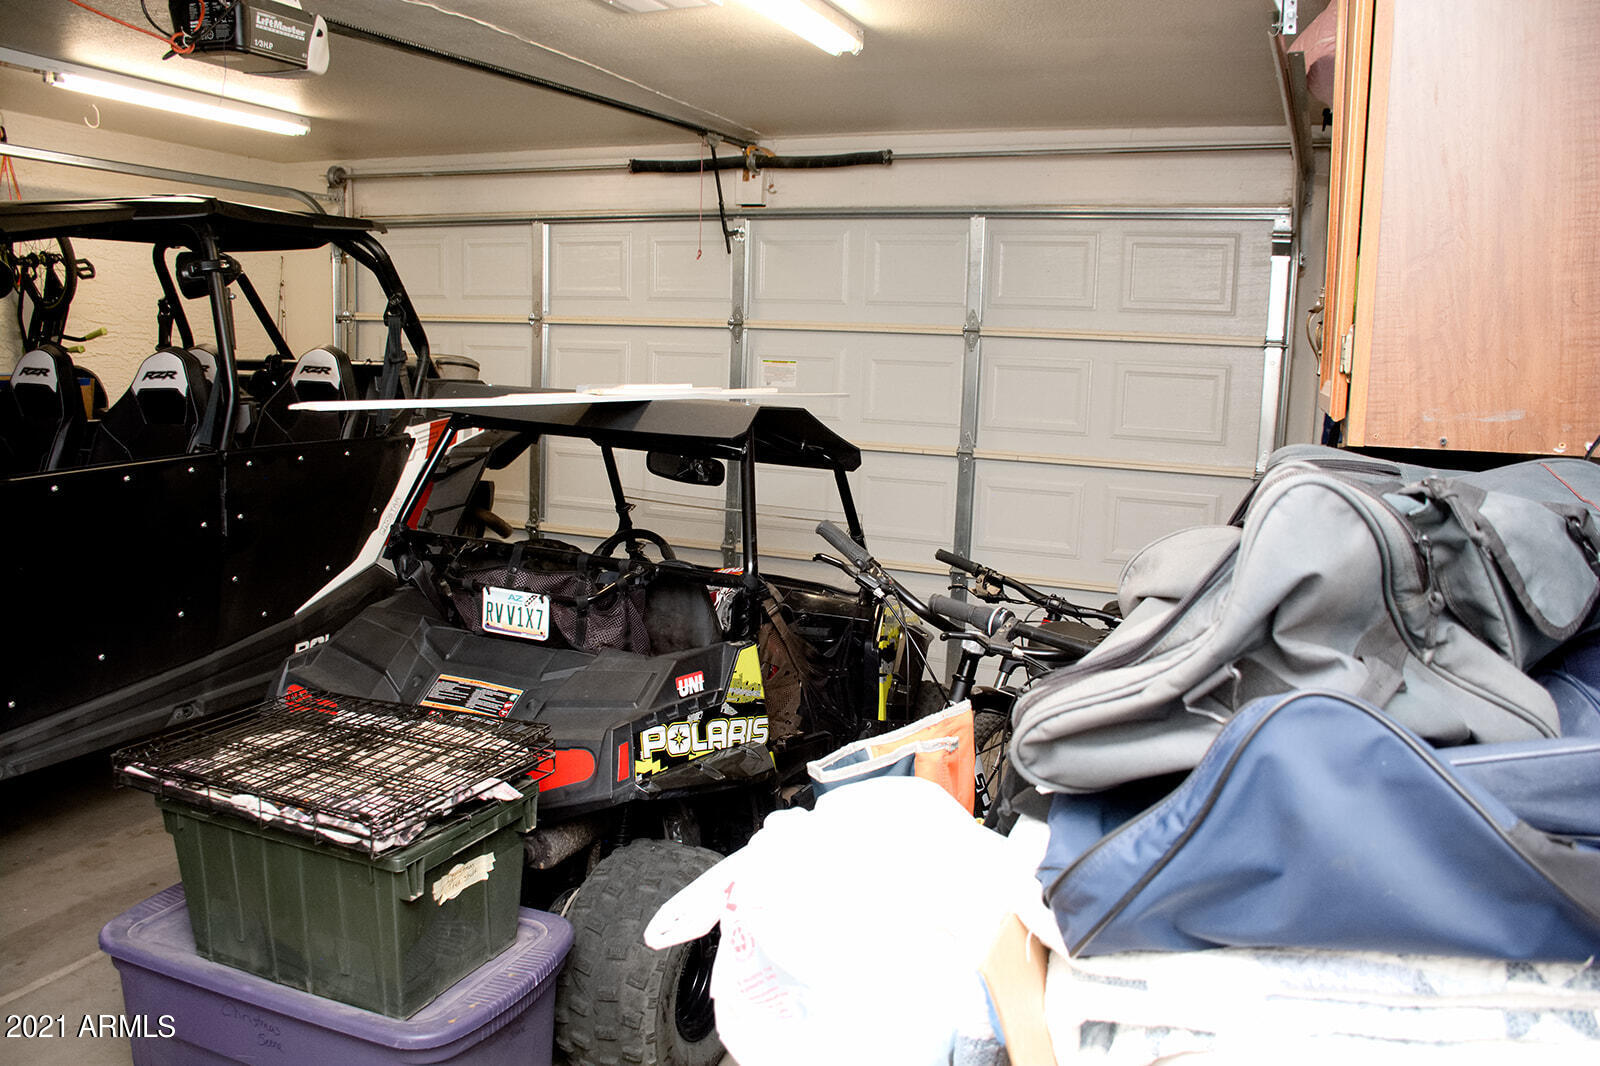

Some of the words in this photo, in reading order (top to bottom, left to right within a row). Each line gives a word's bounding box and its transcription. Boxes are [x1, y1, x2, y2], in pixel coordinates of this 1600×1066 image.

[256, 14, 306, 37] LiftMaster
[19, 366, 50, 377] RZR
[142, 370, 178, 381] RZR
[299, 365, 332, 375] RZR
[507, 594, 525, 602] AZ
[676, 673, 705, 698] UNI
[640, 715, 769, 761] POLARIS
